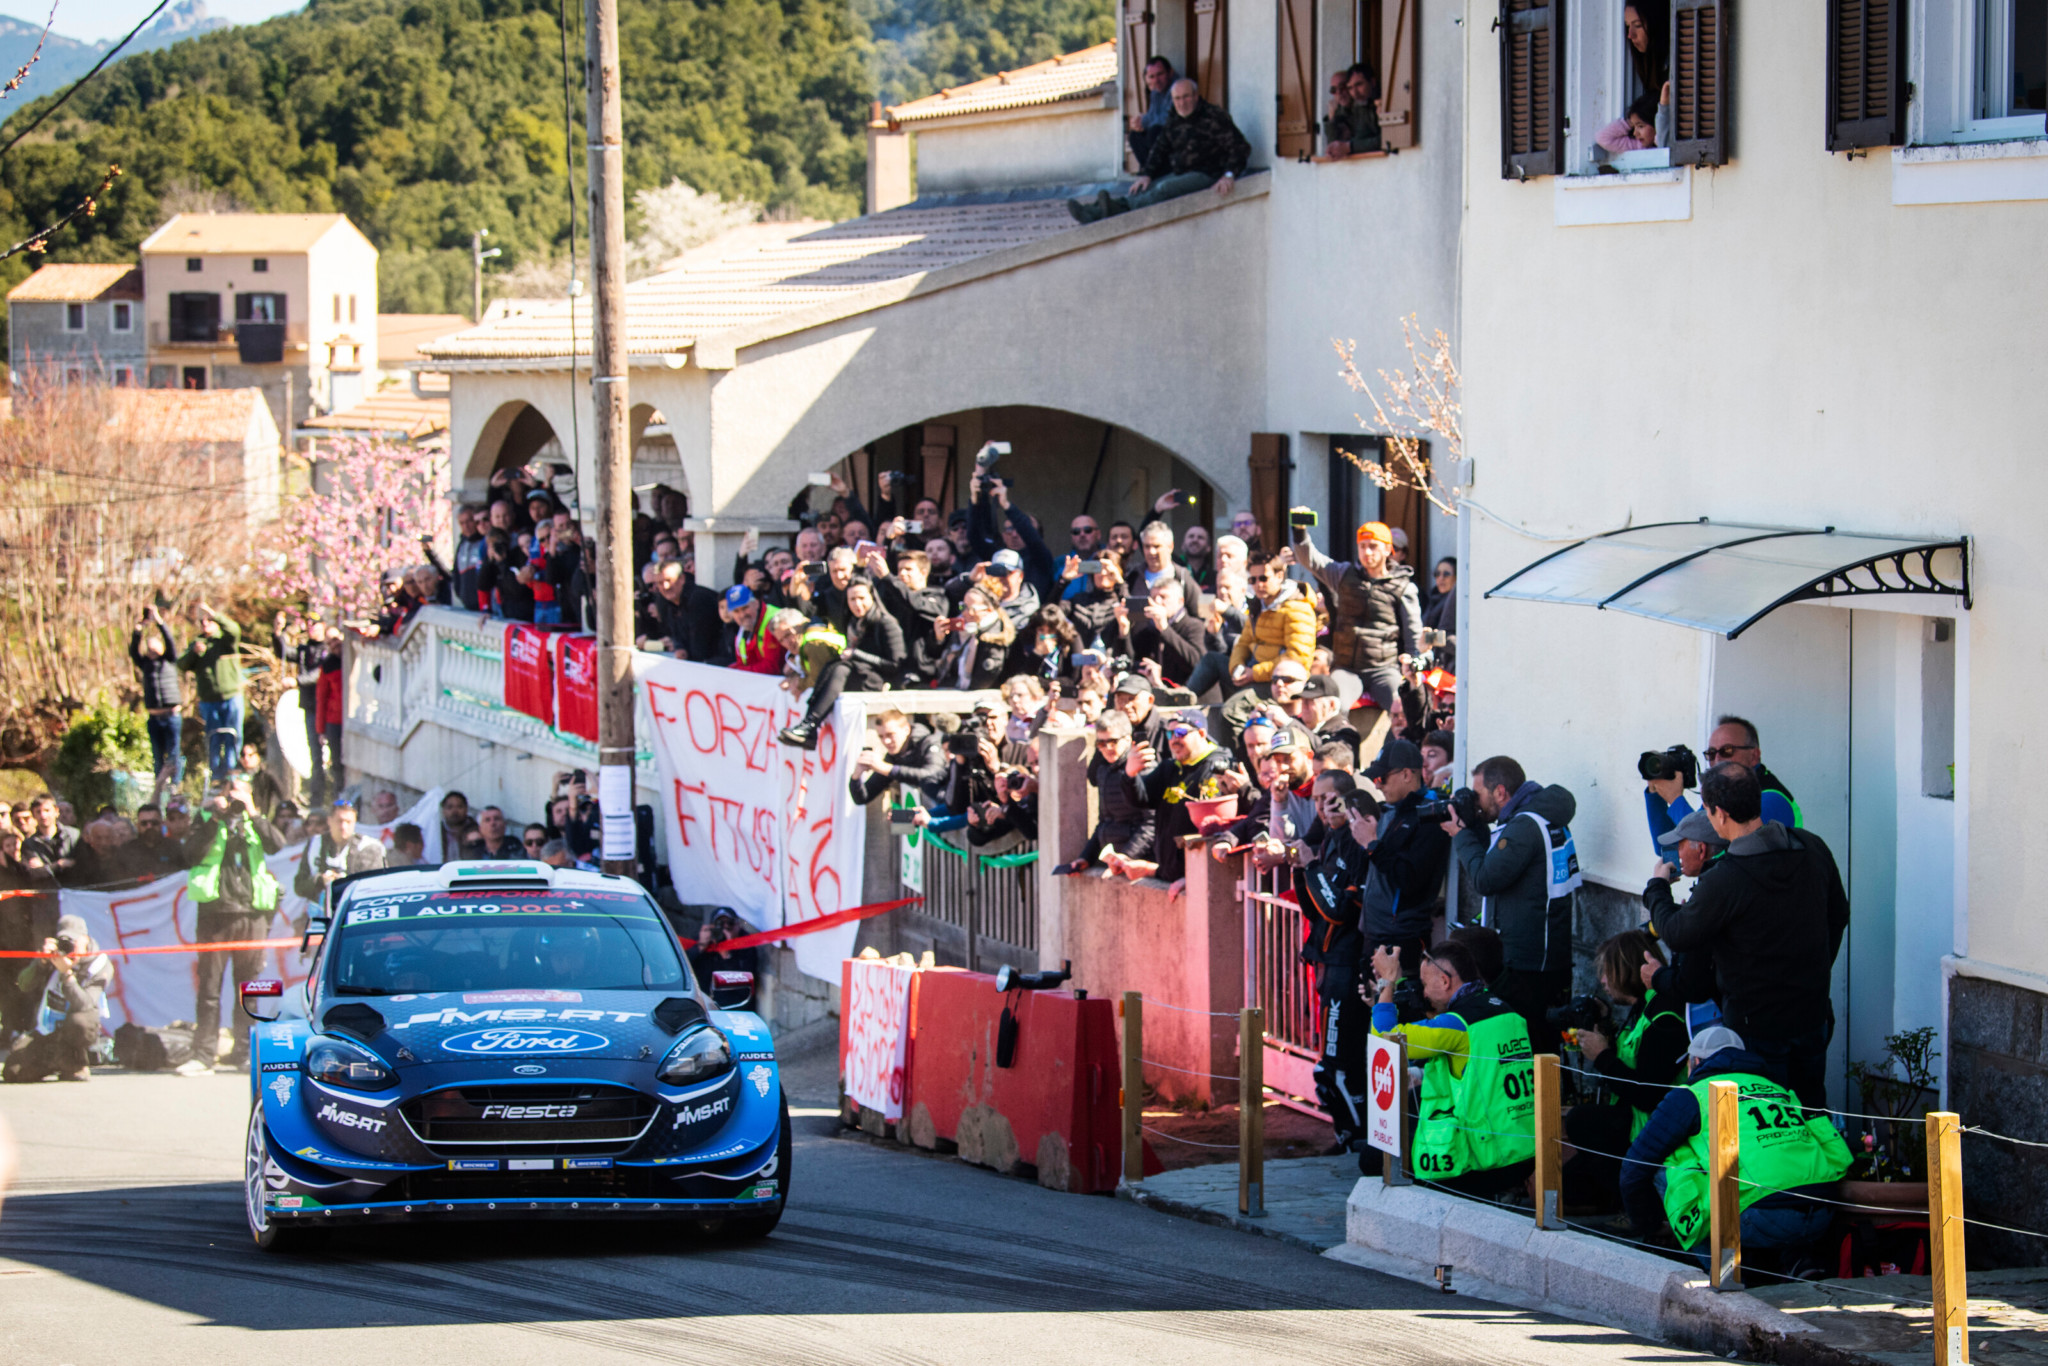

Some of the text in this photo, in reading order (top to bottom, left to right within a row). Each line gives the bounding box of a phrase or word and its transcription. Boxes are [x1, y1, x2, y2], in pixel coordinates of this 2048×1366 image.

[353, 890, 638, 909] FORD PERFORMANCE
[356, 903, 562, 921] 33 AUTODOC
[472, 1031, 580, 1050] Ford
[1497, 1037, 1530, 1055] WRC
[740, 1052, 774, 1060] AUDES
[262, 1062, 298, 1071] AUDES
[482, 1104, 578, 1119] Fiesta
[1747, 1104, 1805, 1131] 125
[1379, 1117, 1388, 1129] NO
[1374, 1130, 1393, 1146] PUBLIC
[684, 1145, 745, 1161] MICHELIN
[1419, 1153, 1454, 1172] 013
